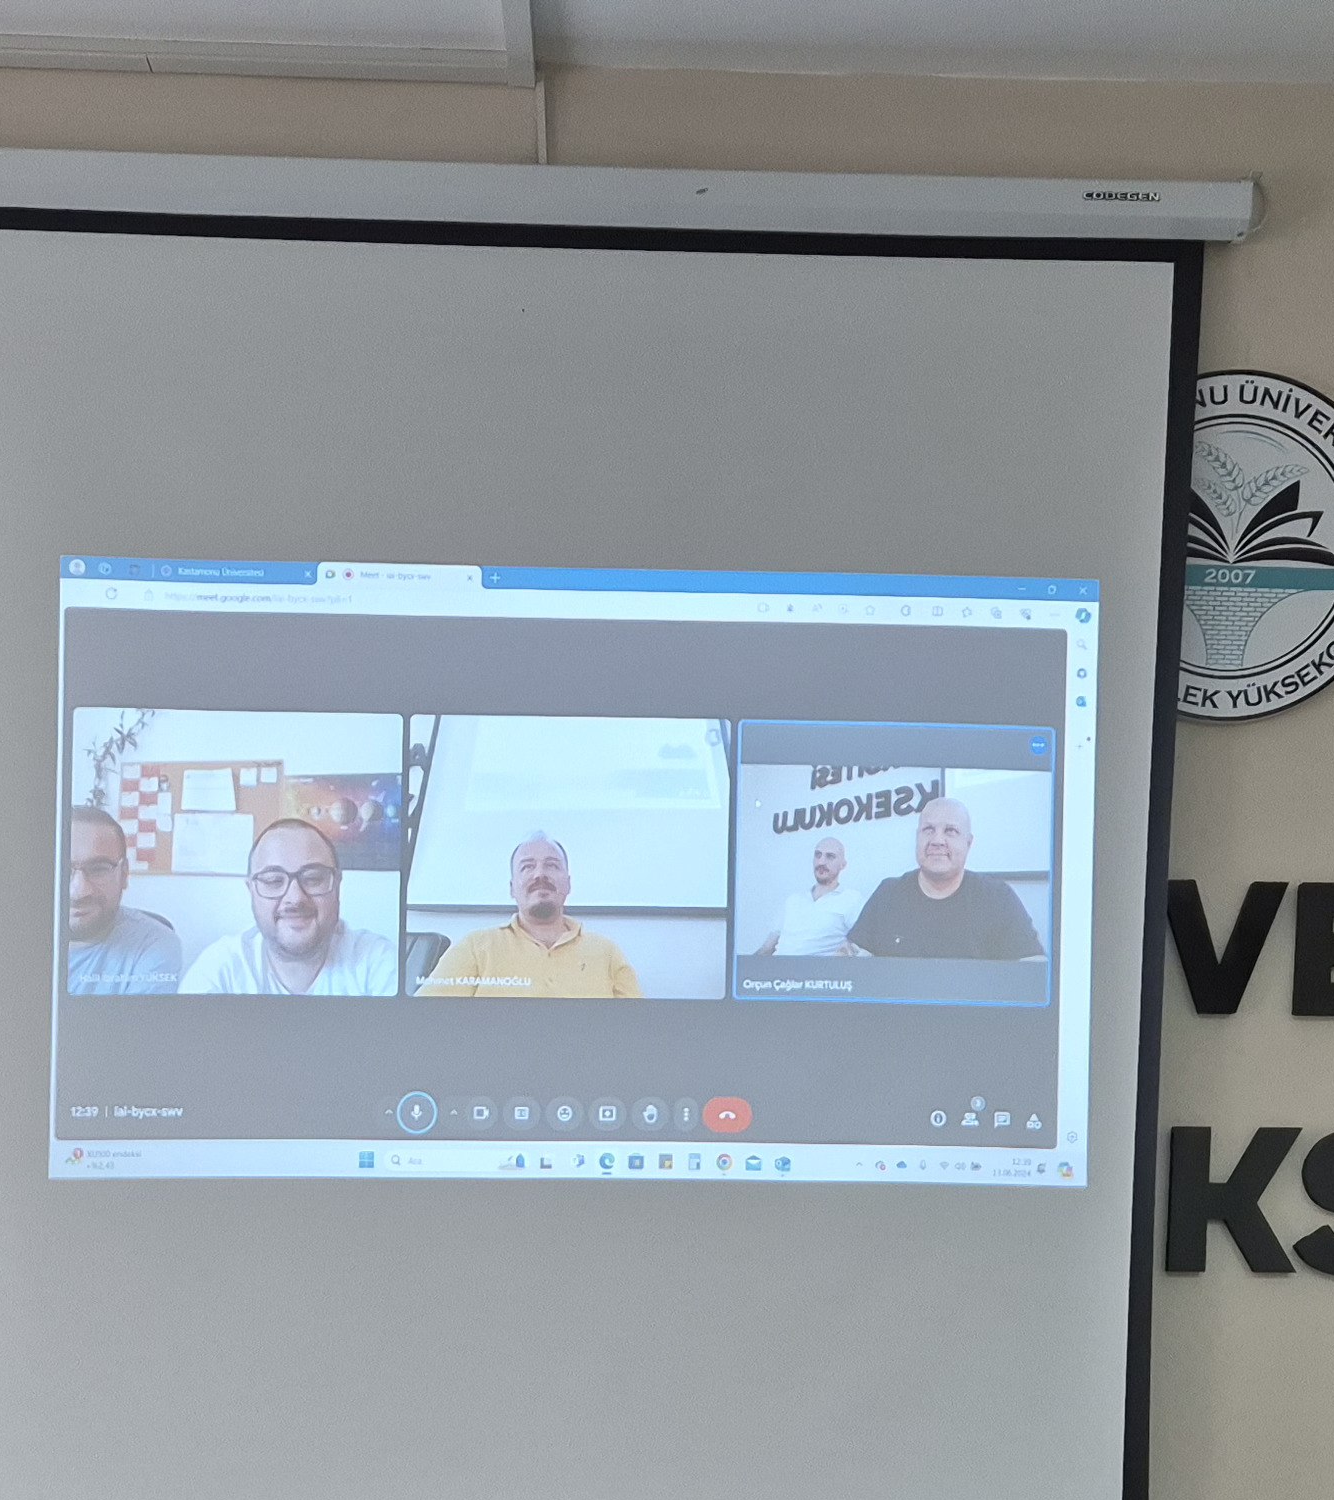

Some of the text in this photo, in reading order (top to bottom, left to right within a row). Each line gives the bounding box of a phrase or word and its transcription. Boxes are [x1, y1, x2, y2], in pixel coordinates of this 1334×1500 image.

[1082, 190, 1161, 202] CODEGEN
[1203, 568, 1257, 585] 2007
[1177, 683, 1222, 709] EK
